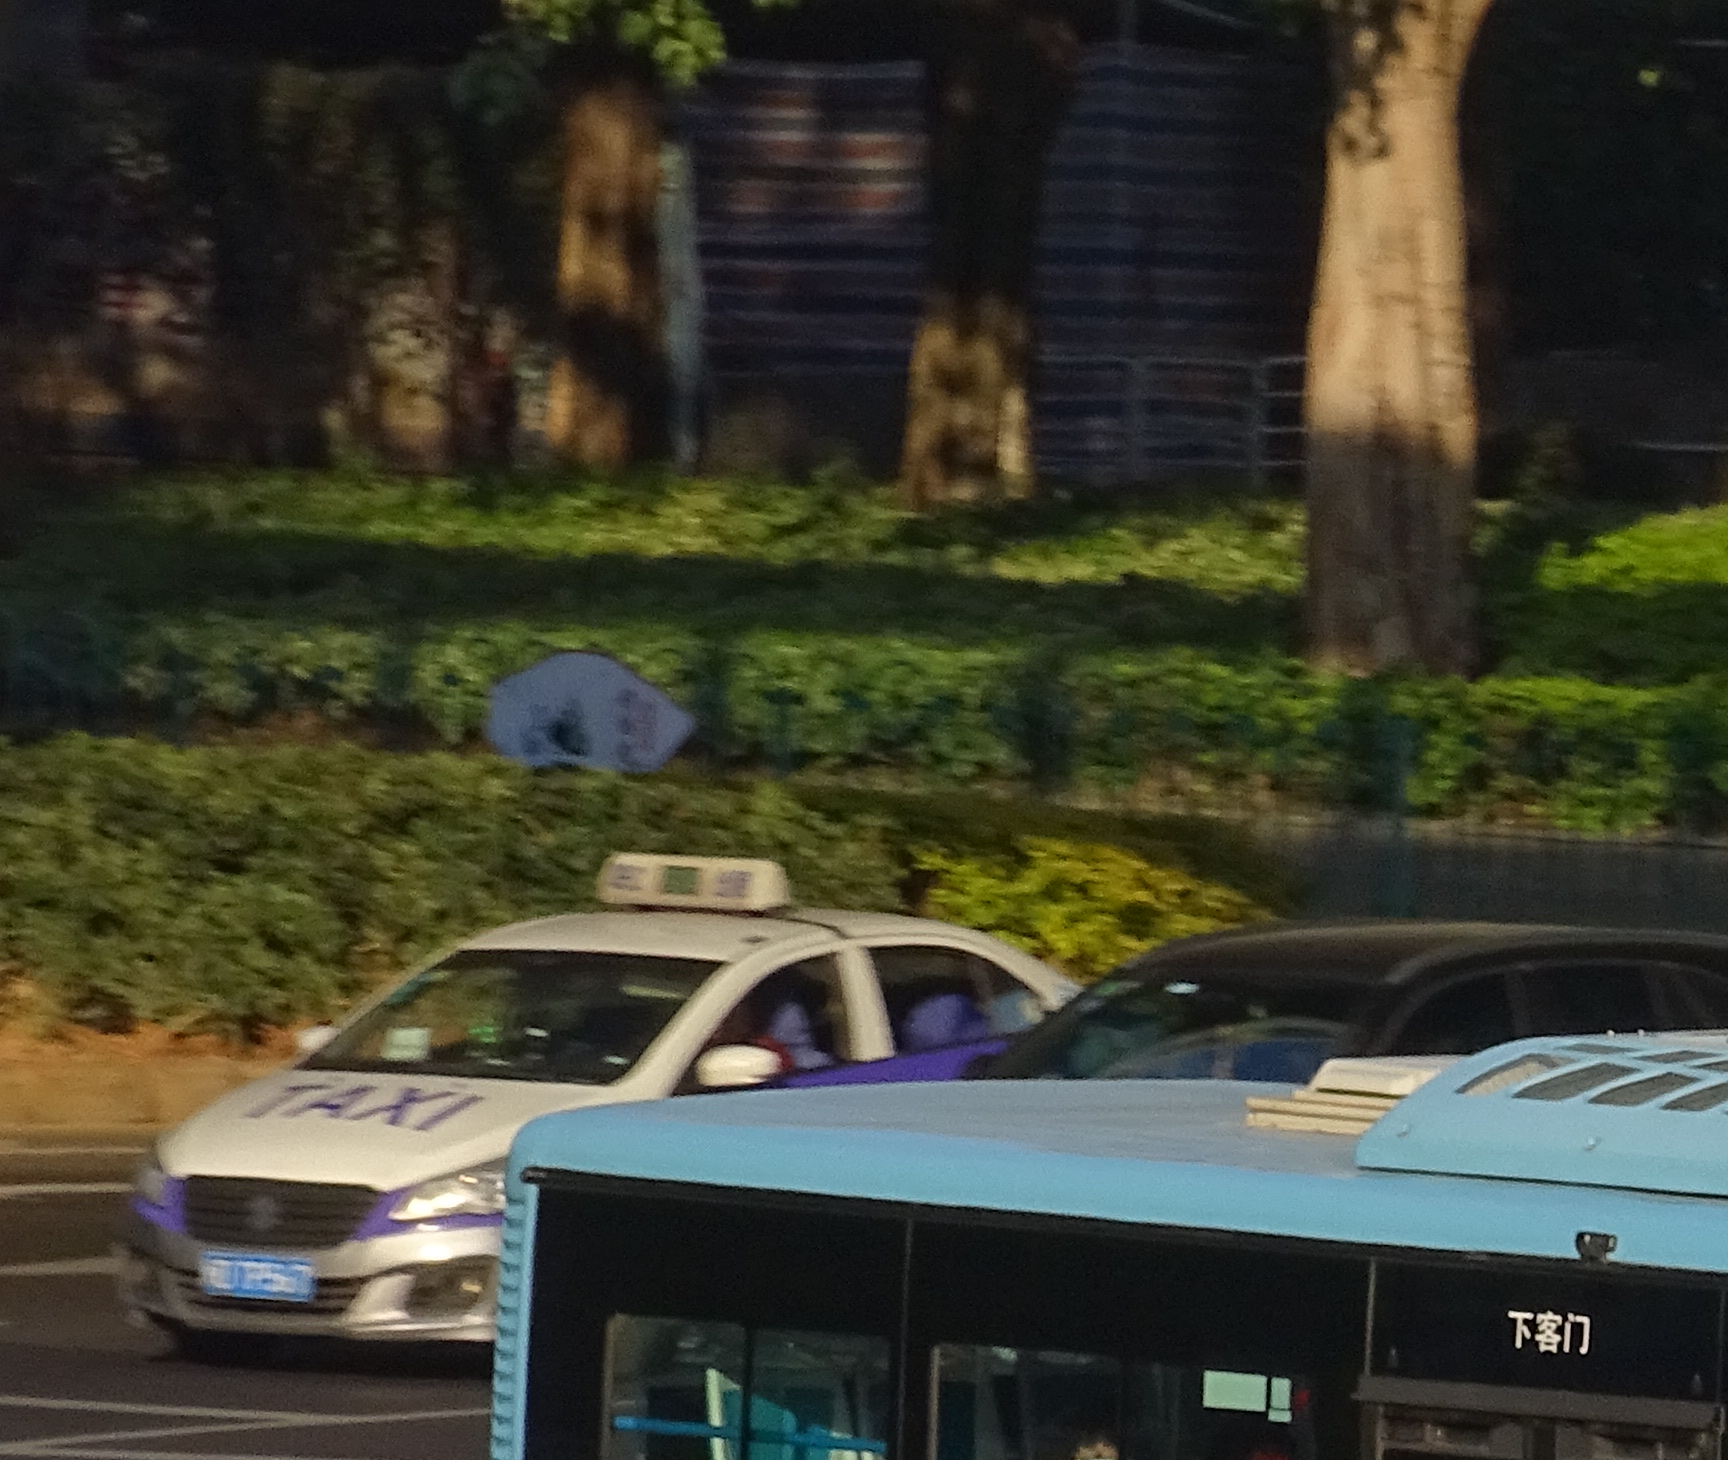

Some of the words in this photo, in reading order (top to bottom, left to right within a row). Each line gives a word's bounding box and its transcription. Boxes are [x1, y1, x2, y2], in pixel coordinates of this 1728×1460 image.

[243, 1085, 485, 1131] TAXI
[1507, 1309, 1592, 1355] 下客门
